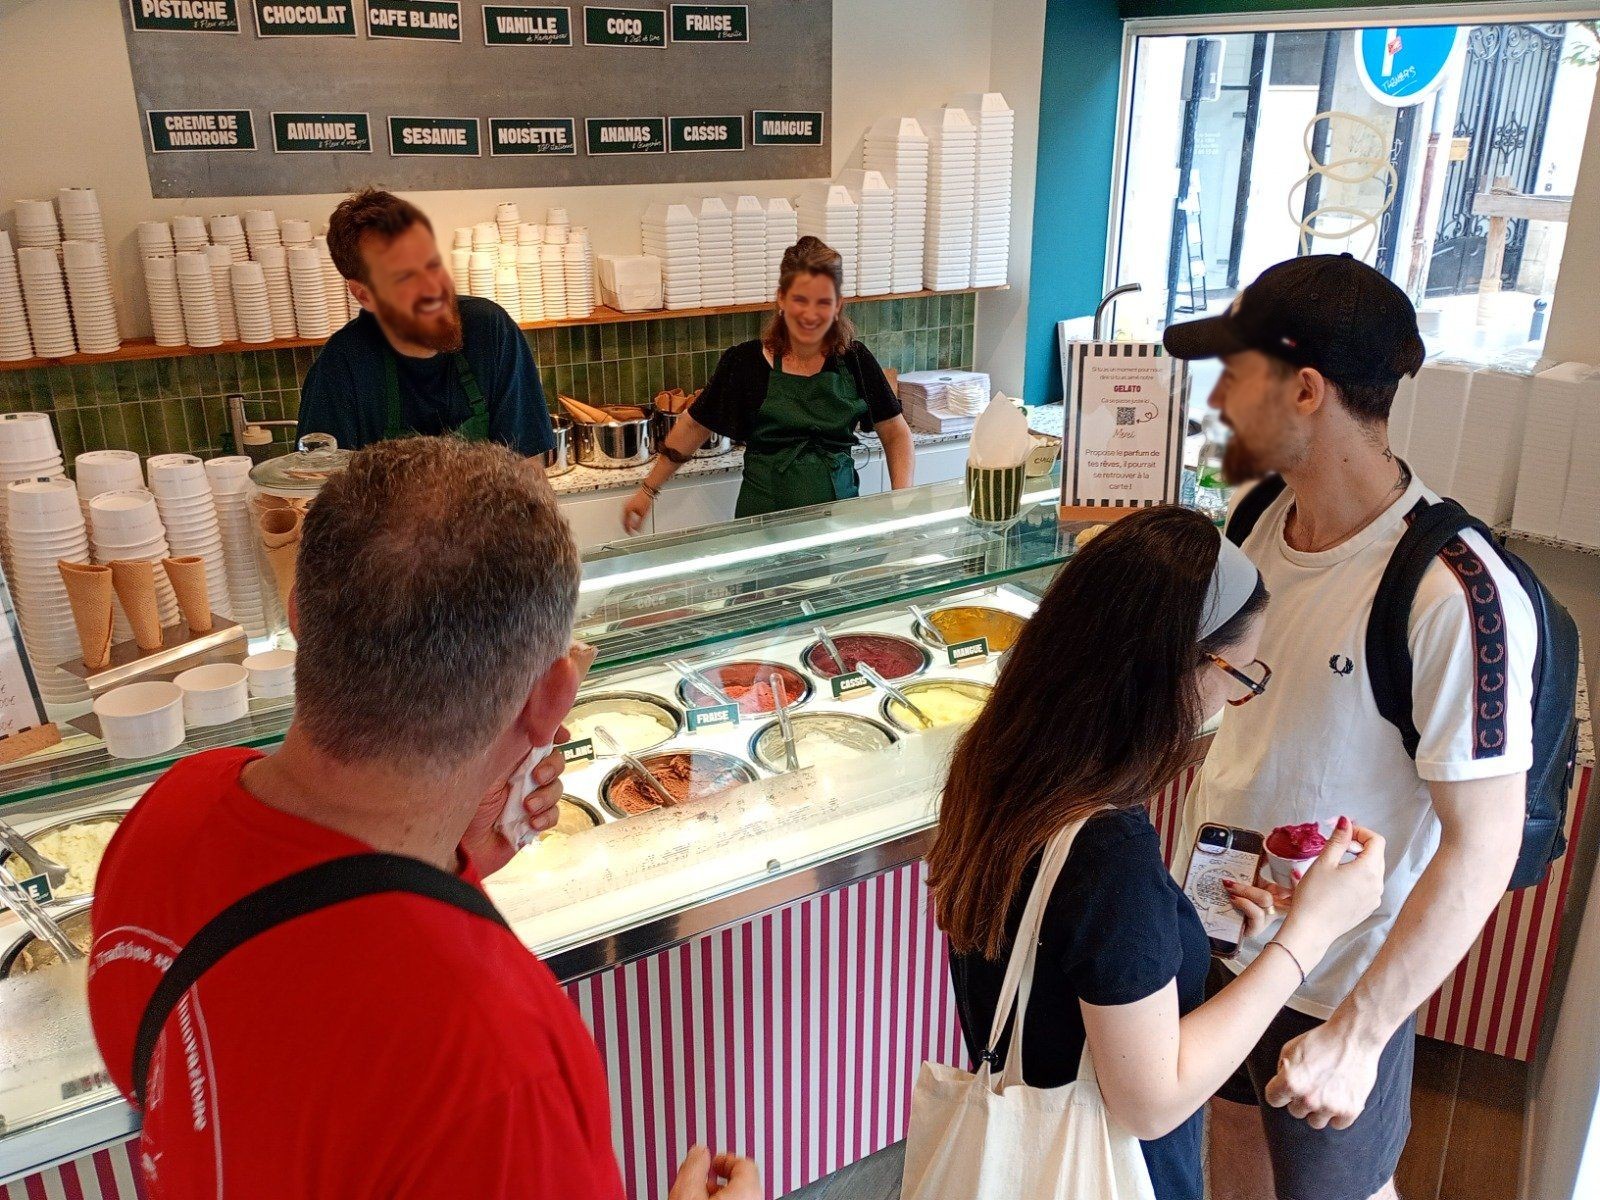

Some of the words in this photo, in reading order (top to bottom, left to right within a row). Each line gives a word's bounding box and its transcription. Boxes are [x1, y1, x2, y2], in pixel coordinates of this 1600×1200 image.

[142, 0, 228, 20] PISTACHE
[262, 5, 347, 24] CHOCOLAT
[369, 8, 407, 27] CAFE
[410, 12, 458, 30] BLANC
[496, 16, 558, 34] VANILLE
[606, 17, 642, 35] COCO
[685, 14, 732, 31] FRAISE
[164, 114, 216, 131] CREME
[218, 114, 238, 131] DE
[287, 122, 357, 140] AMANDE
[762, 119, 813, 136] MANGUE
[169, 130, 238, 146] MARRONS
[402, 127, 467, 145] SESAME
[498, 127, 567, 144] NOISETTE
[600, 126, 651, 143] ANANAS
[683, 125, 728, 142] CASSIS
[1113, 385, 1141, 393] GELATO
[1085, 449, 1115, 457] Propose
[1123, 449, 1149, 457] parfum
[1127, 460, 1156, 469] pourrait
[952, 643, 984, 659] MANGUE
[840, 676, 868, 690] CASSIS
[696, 710, 730, 724] FRAISE
[563, 744, 593, 760] BLANC
